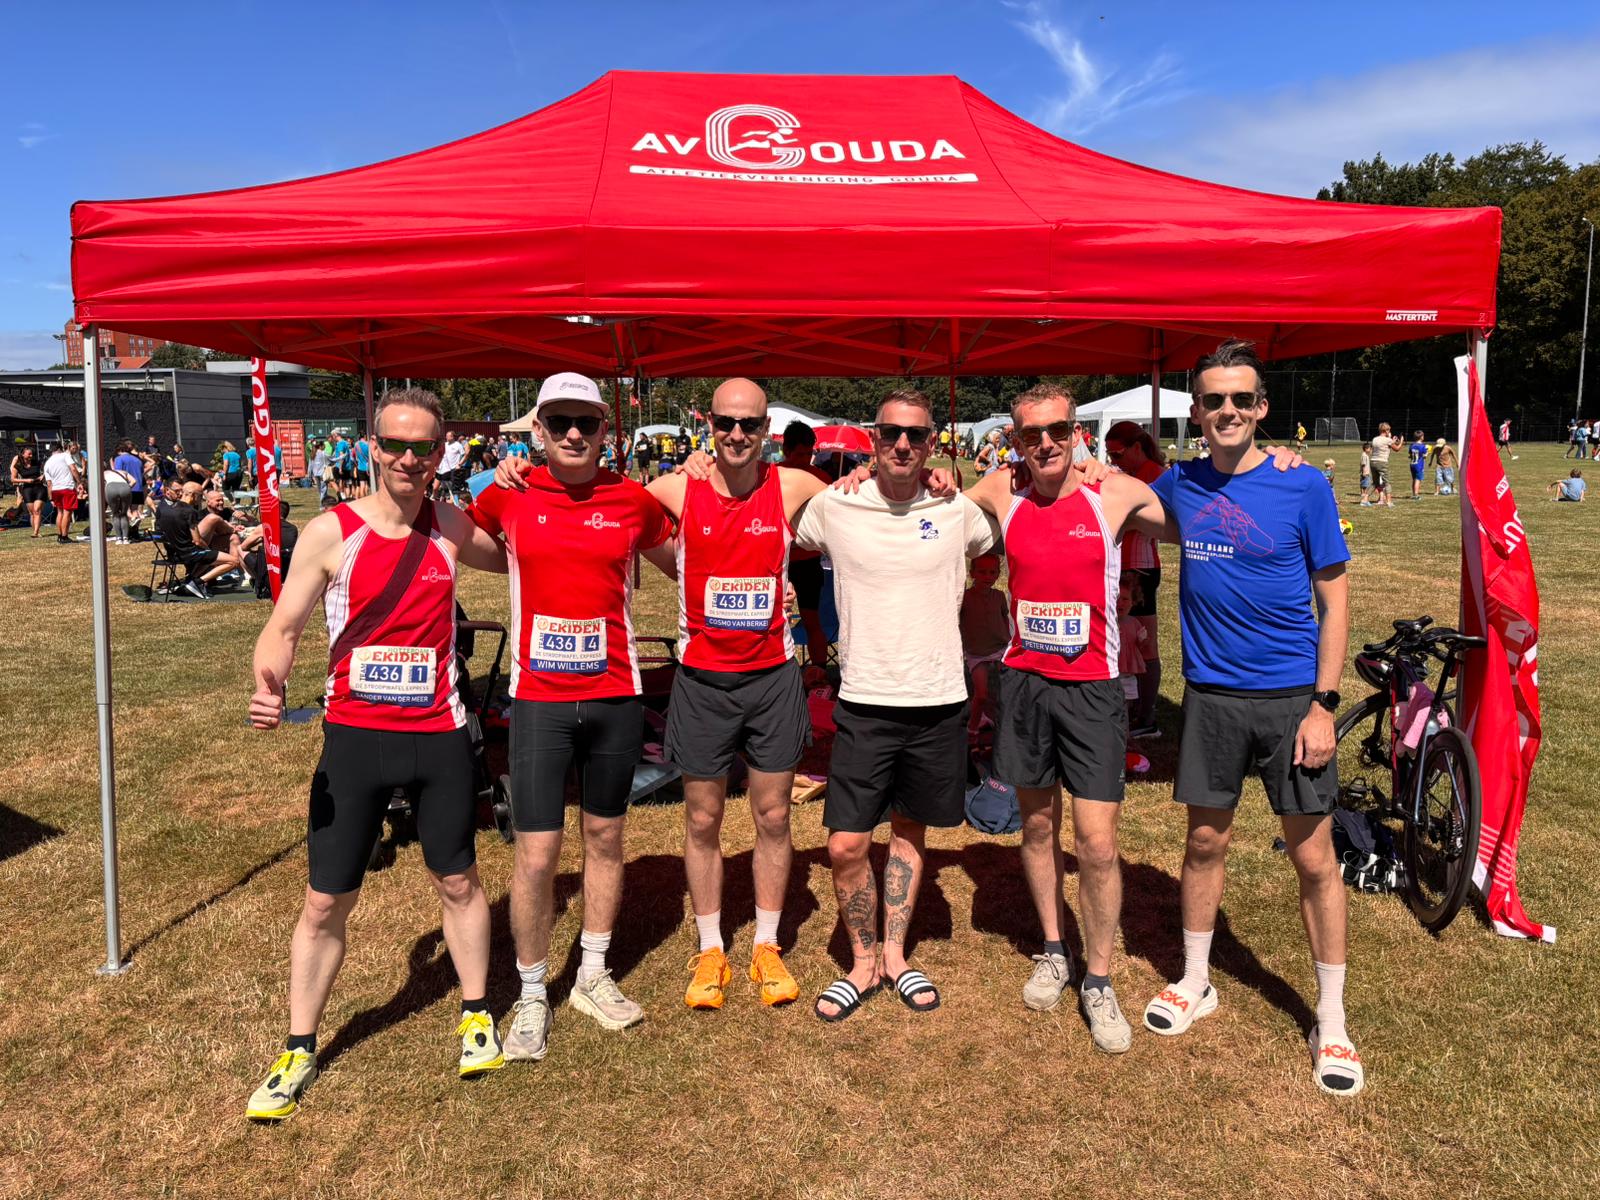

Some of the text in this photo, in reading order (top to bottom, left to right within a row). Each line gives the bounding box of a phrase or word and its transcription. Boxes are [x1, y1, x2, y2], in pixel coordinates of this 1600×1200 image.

[631, 132, 700, 155] AV
[645, 167, 958, 184] ATLETIEKVERENIGING GOUDA
[1385, 313, 1438, 321] MASTERTENT
[722, 582, 770, 592] EKIDEN
[719, 595, 745, 608] 436
[758, 595, 766, 608] 2
[1031, 607, 1082, 617] EKIDEN
[549, 622, 601, 634] EKIDEN
[709, 618, 731, 627] COSMO
[1030, 619, 1055, 634] 436
[1069, 620, 1078, 634] 5
[545, 635, 573, 650] 436
[588, 637, 597, 650] 4
[1025, 641, 1045, 650] PETER
[1044, 644, 1059, 652] VAN
[372, 651, 430, 663] EKIDEN
[537, 661, 600, 671] WIM WILLEMS
[368, 666, 400, 681] 436
[417, 667, 423, 682] 1
[355, 693, 382, 701] SANDER
[1319, 1044, 1361, 1063] HOKA
